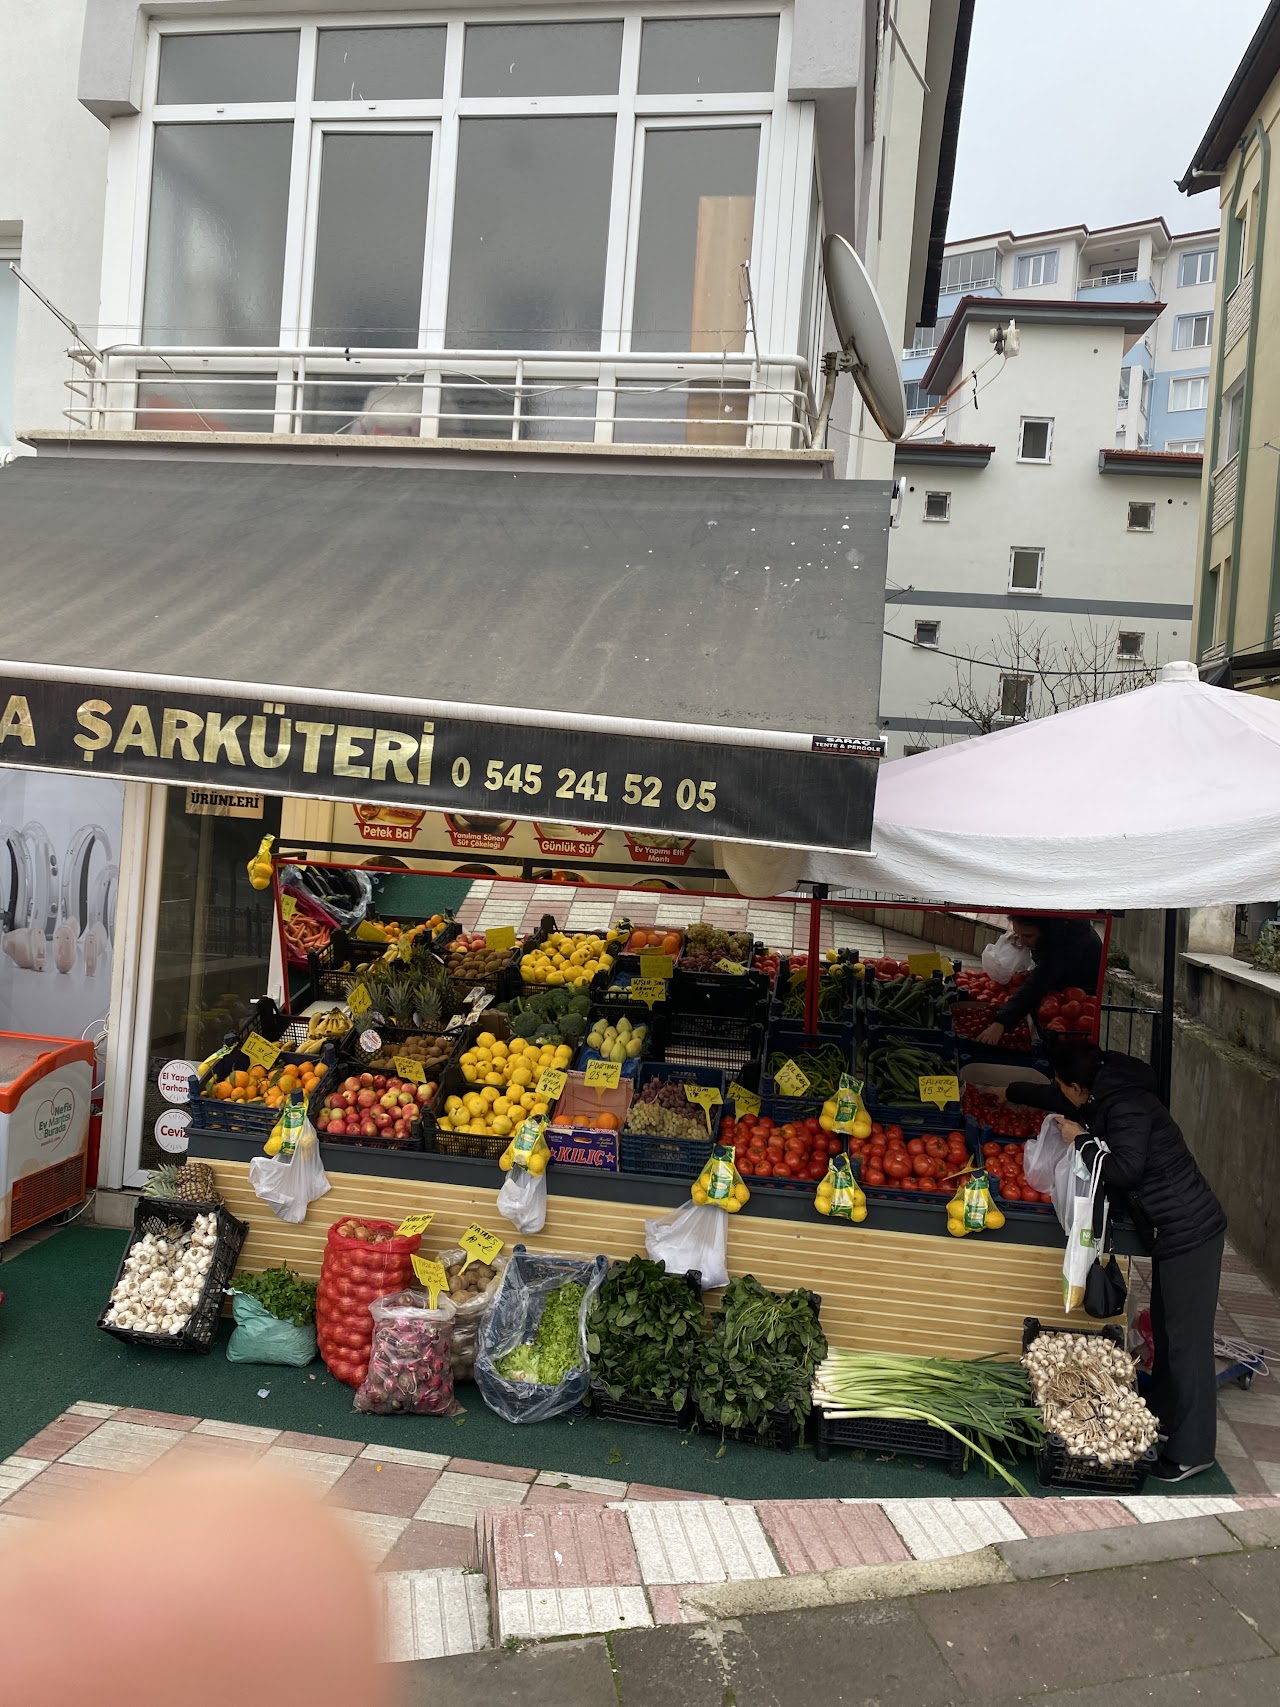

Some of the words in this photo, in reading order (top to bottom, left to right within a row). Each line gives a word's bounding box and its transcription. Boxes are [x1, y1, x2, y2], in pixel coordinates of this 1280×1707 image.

[847, 744, 881, 752] PERGOLE
[73, 699, 434, 786] ŞARKÜTERİ
[451, 757, 471, 787] 0
[484, 760, 543, 795] 545
[555, 768, 608, 802] 241
[622, 773, 661, 807] 52
[676, 778, 717, 812] 05
[191, 789, 260, 808] ÜRÜNLERİ
[363, 825, 393, 839] Petek
[395, 828, 413, 840] Bal
[541, 840, 576, 853] Günlük
[578, 843, 596, 854] Süt
[162, 1072, 169, 1080] El
[54, 1102, 73, 1116] Nefis
[556, 1146, 606, 1167] KILIÇ
